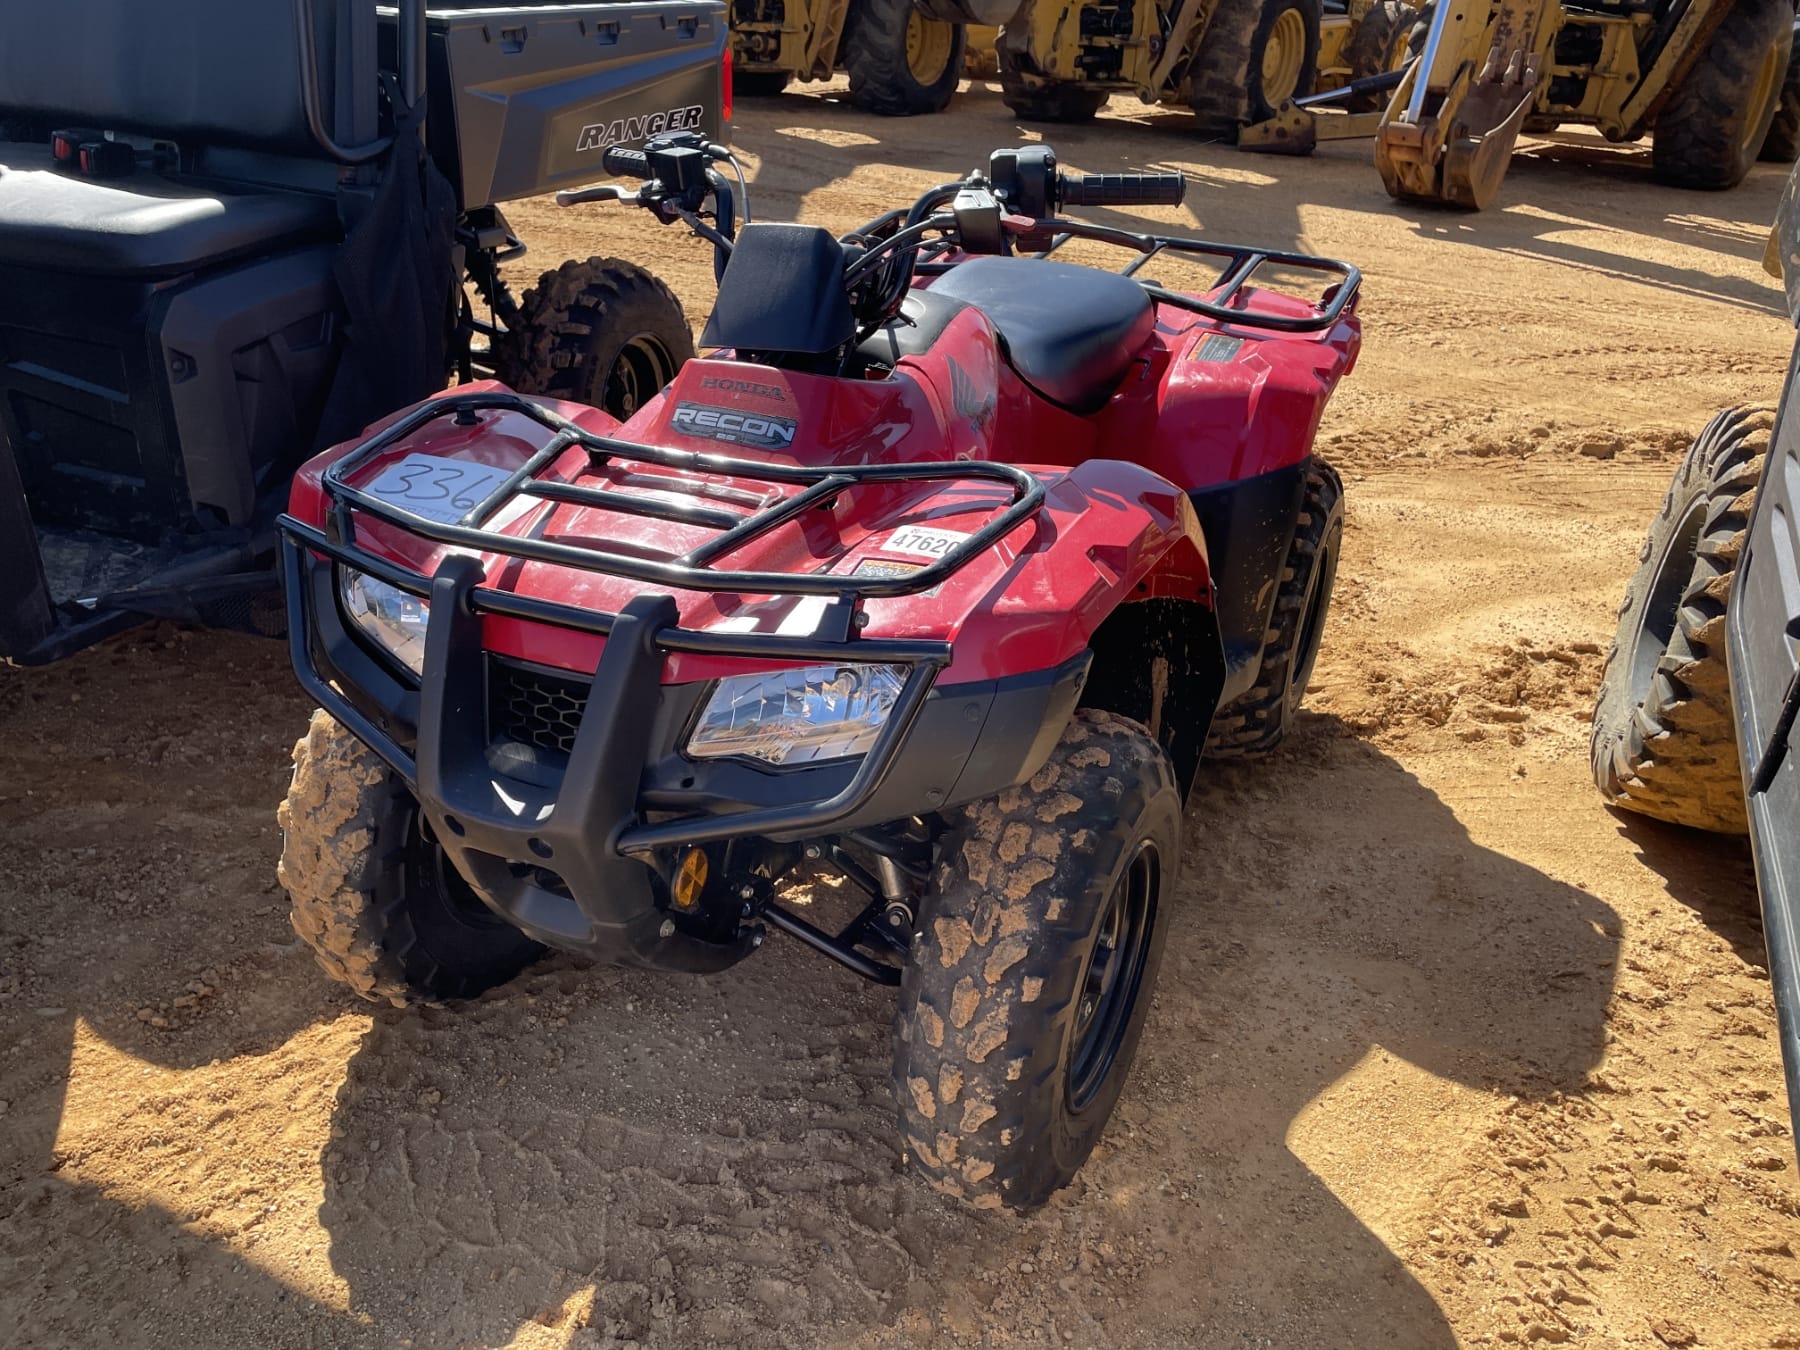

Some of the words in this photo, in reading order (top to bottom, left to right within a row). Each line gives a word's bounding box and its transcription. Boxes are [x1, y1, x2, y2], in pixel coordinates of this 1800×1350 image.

[576, 105, 703, 152] RANGER
[702, 377, 786, 401] HONDA
[672, 408, 795, 442] RECON
[374, 464, 493, 509] 336
